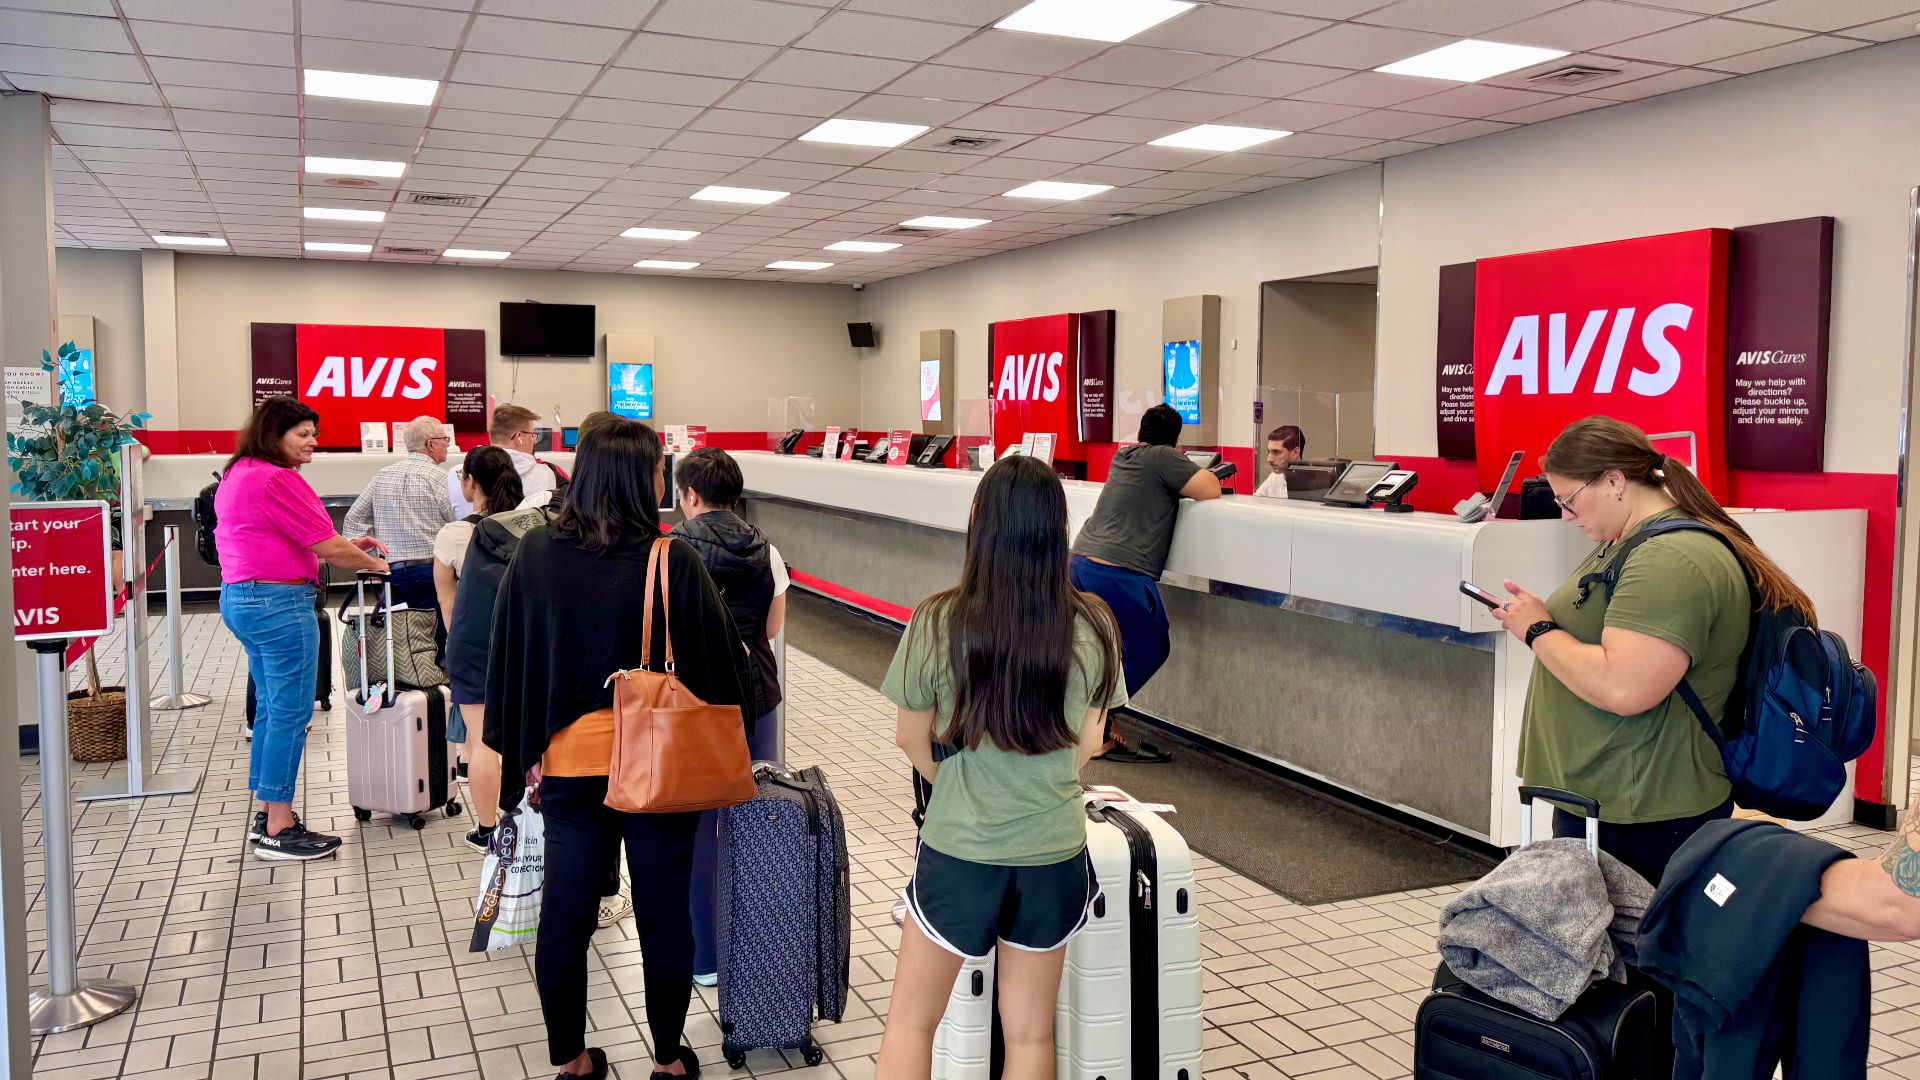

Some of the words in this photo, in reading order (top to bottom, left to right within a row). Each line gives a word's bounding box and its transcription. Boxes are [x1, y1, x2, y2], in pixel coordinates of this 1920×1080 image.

[1485, 304, 1692, 396] AVIS
[306, 357, 437, 399] AVIS
[997, 351, 1063, 402] AVIS
[1736, 379, 1752, 388] May
[1768, 378, 1786, 387] help
[1788, 378, 1806, 386] with
[1748, 388, 1792, 396] directions?
[1764, 397, 1791, 406] buckle
[1794, 398, 1807, 406] up,
[1732, 406, 1756, 416] adjust
[1758, 408, 1776, 416] your
[1779, 406, 1809, 414] mirrors
[1738, 416, 1752, 424] and
[1755, 416, 1774, 424] drive
[1778, 416, 1804, 426] safely.
[43, 520, 80, 534] your
[12, 566, 45, 578] nter
[49, 562, 91, 576] here.
[260, 836, 280, 848] HOKA
